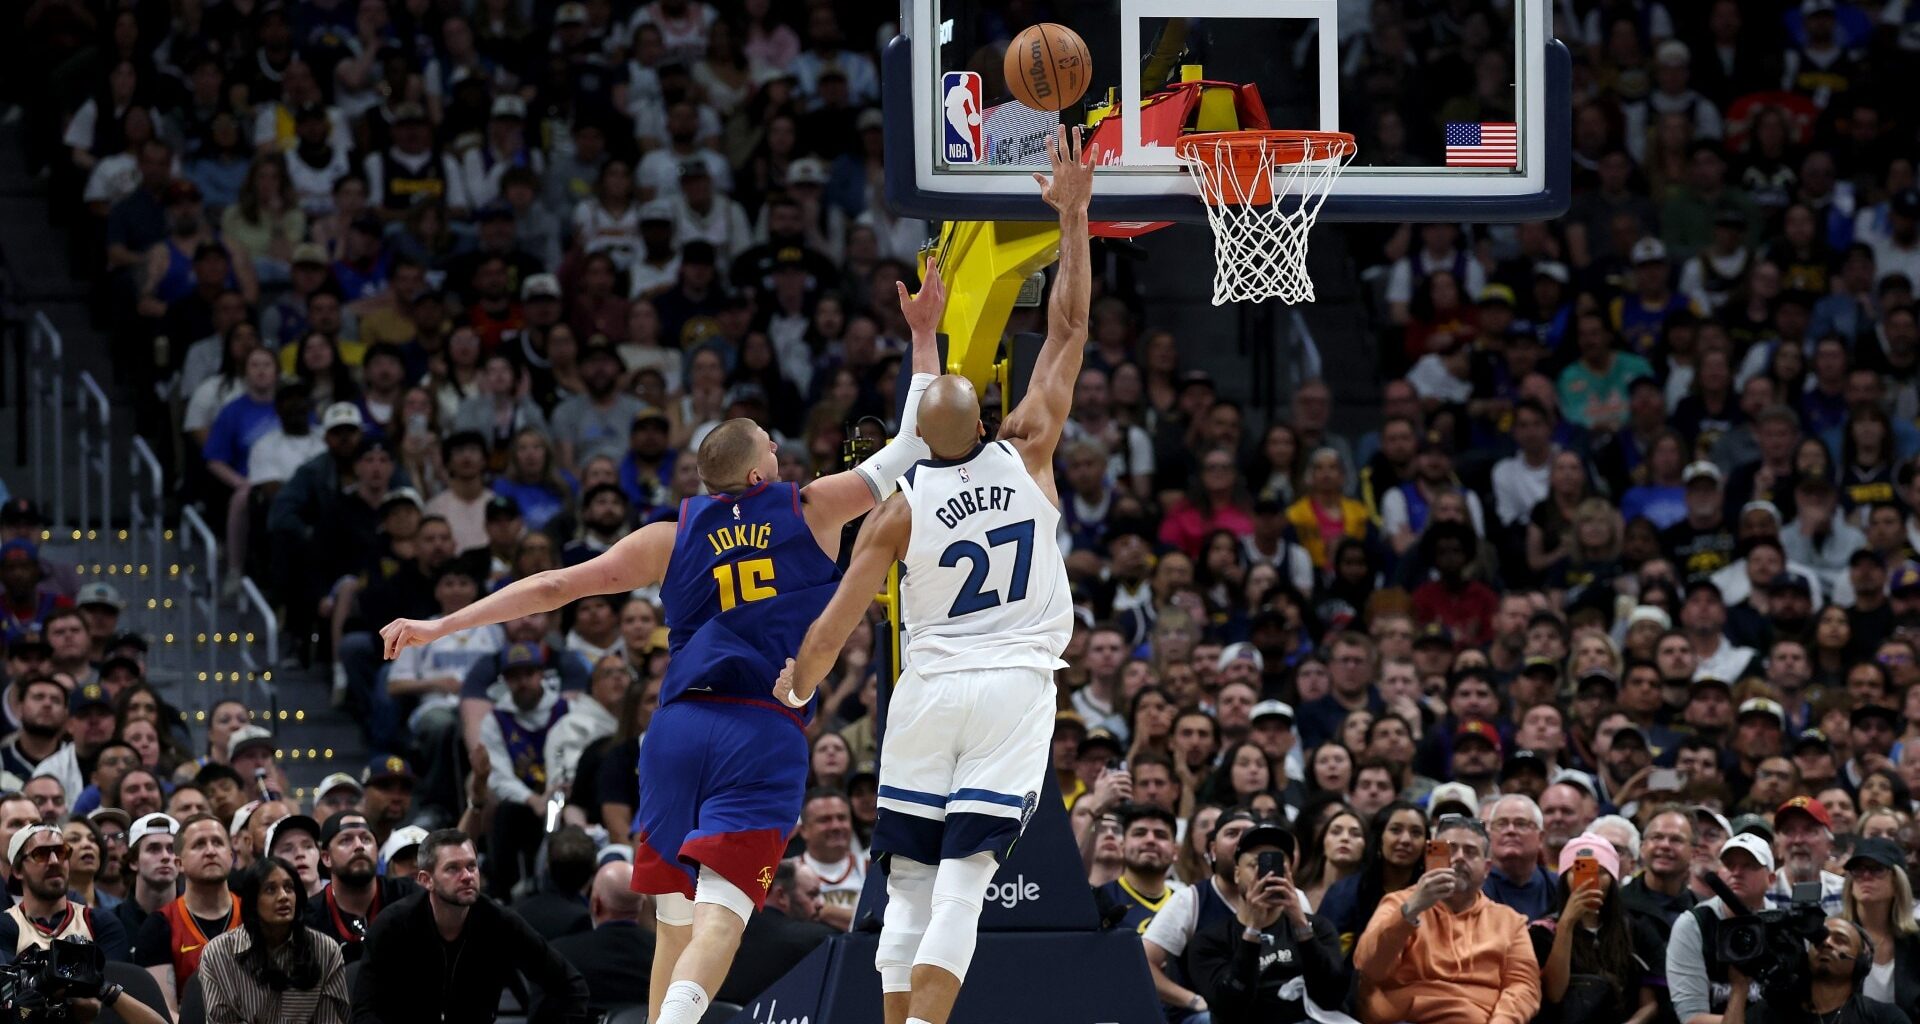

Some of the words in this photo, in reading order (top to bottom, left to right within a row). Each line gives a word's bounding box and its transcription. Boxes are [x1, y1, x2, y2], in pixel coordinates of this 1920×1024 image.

[1029, 40, 1052, 99] Wilson
[949, 143, 968, 159] NBA
[935, 486, 1016, 530] GOBERT
[707, 522, 771, 556] JOKIĆ
[712, 558, 777, 613] 15
[938, 519, 1036, 619] 27
[983, 873, 1040, 909] ogle
